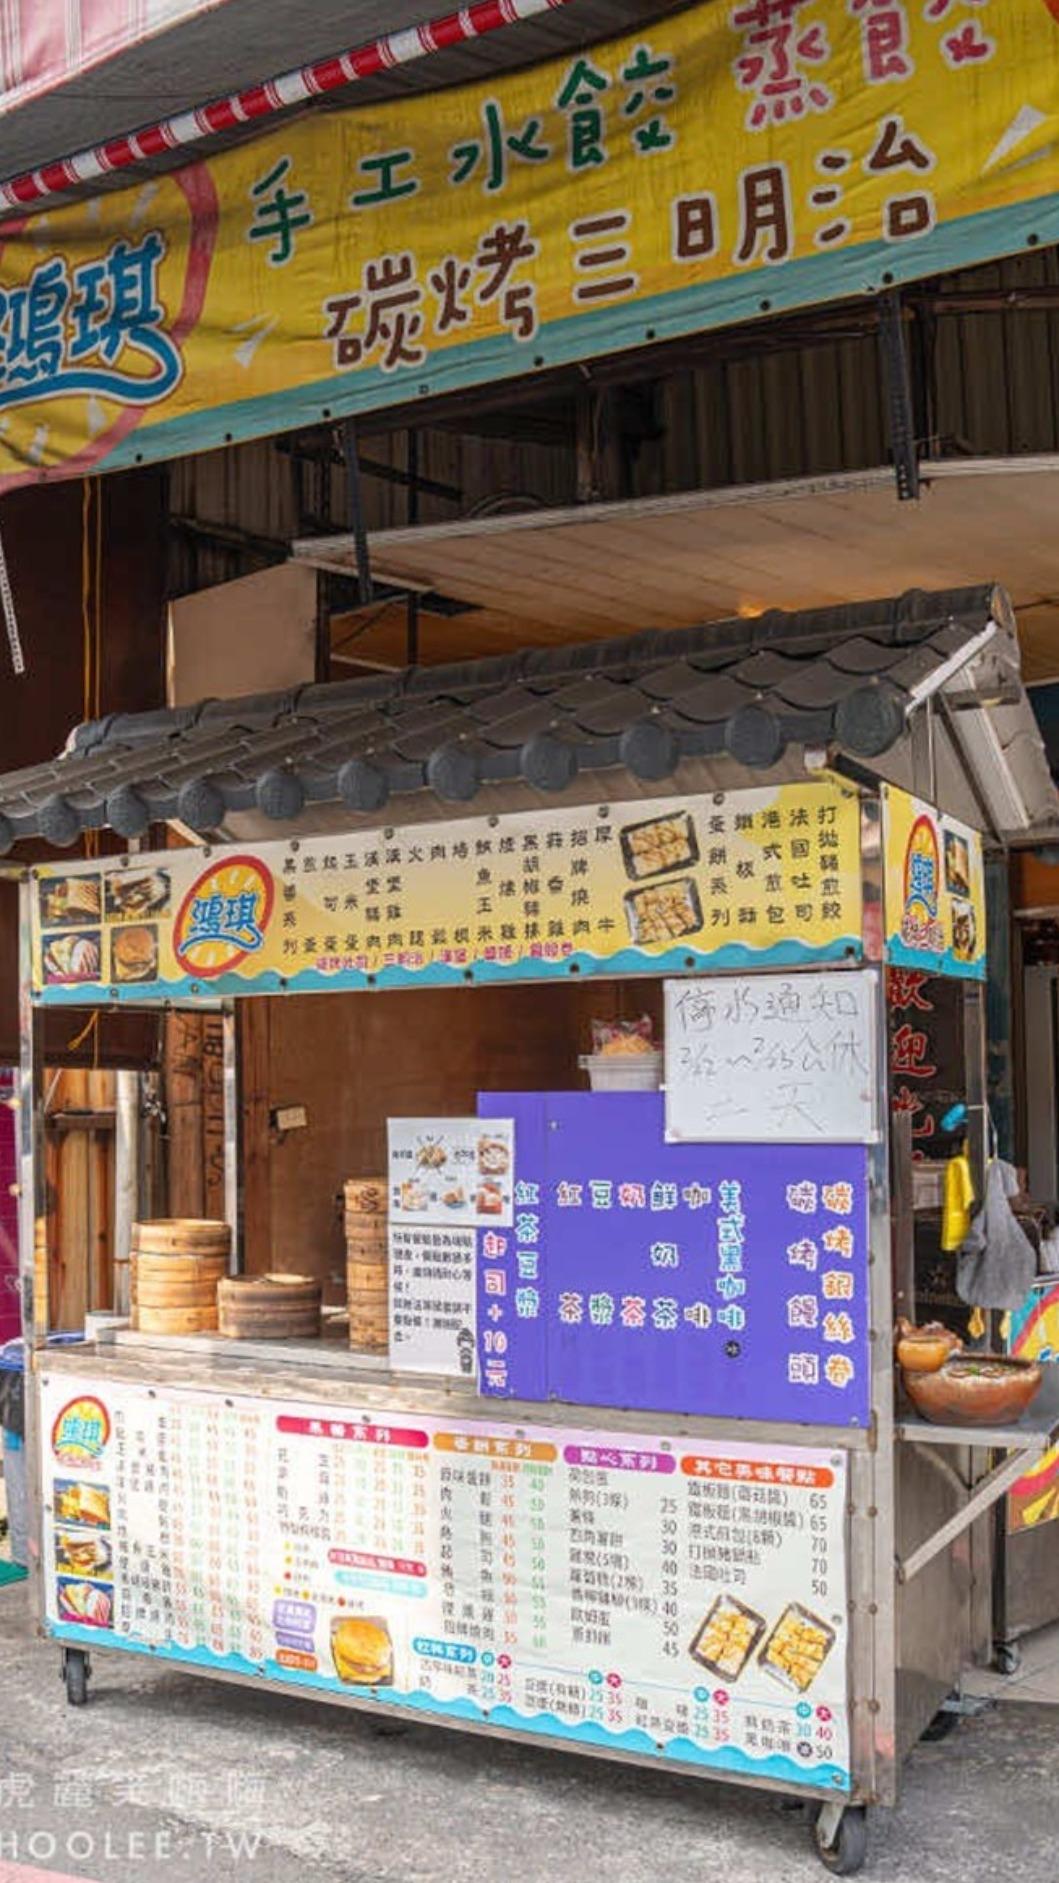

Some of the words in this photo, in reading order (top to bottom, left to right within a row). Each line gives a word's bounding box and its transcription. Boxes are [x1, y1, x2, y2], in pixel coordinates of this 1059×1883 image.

[247, 45, 676, 267] 手工水餃
[324, 118, 937, 374] 碳烤三明治
[708, 815, 730, 927] 蛋餅系列
[761, 810, 785, 924] 港式煎包
[790, 808, 814, 921] 法國吐司
[189, 890, 263, 940] 鴻琪
[676, 982, 859, 1033] 停水通知
[705, 1082, 824, 1133] 二天
[515, 1181, 540, 1319] 紅茶豆漿
[715, 1181, 745, 1331] 美式黑咖啡
[809, 1493, 828, 1510] 65
[661, 1519, 677, 1536] 30
[810, 1515, 828, 1532] 65
[661, 1539, 677, 1556] 30
[811, 1537, 828, 1554] 70
[662, 1560, 677, 1577] 40
[811, 1558, 828, 1575] 70
[662, 1580, 678, 1597] 35
[811, 1579, 828, 1597] 50
[662, 1601, 677, 1617] 40
[663, 1621, 679, 1637] 50
[663, 1640, 679, 1658] 45
[608, 1708, 623, 1724] 35
[816, 1726, 832, 1741] 40
[816, 1743, 833, 1759] 50
